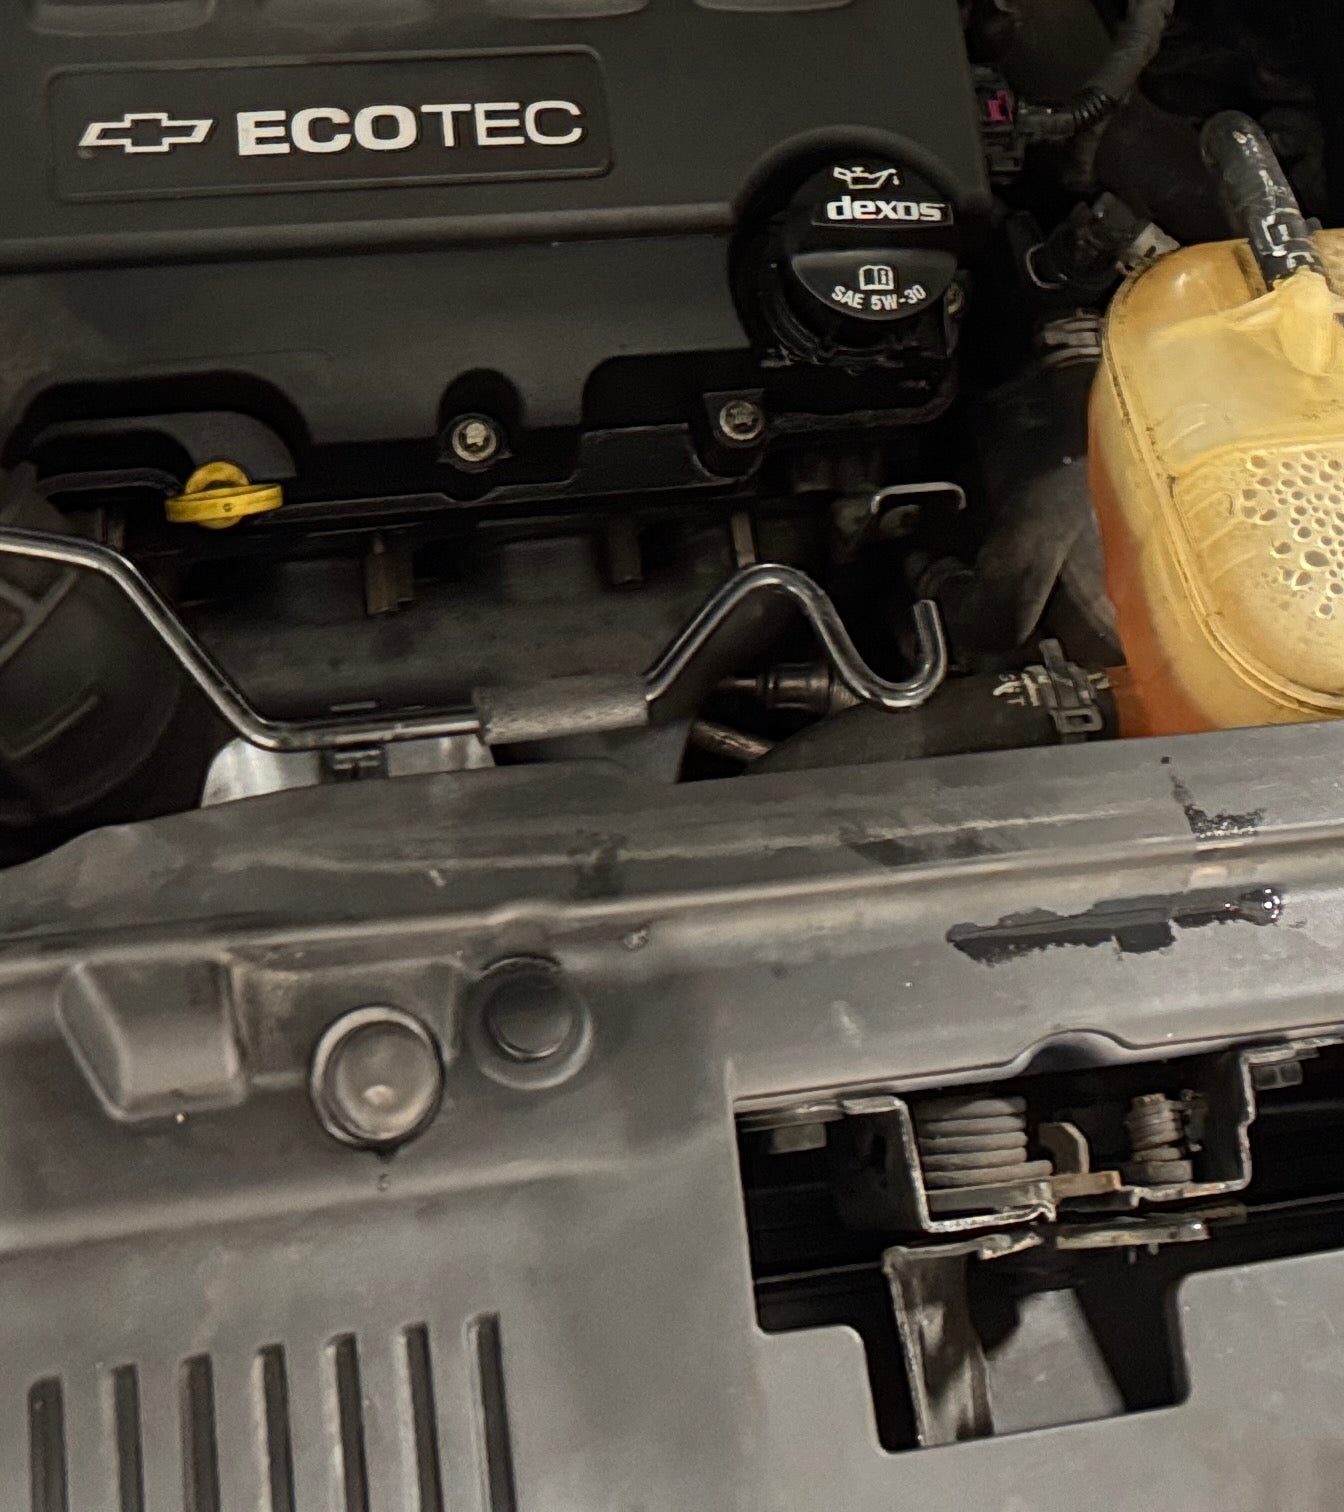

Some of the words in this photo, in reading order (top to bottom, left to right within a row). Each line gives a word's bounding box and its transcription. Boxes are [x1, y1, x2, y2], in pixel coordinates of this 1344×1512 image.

[236, 100, 583, 156] ECOTEC
[826, 196, 945, 221] dexos
[831, 286, 865, 309] SAE
[871, 284, 927, 310] 5W-30
